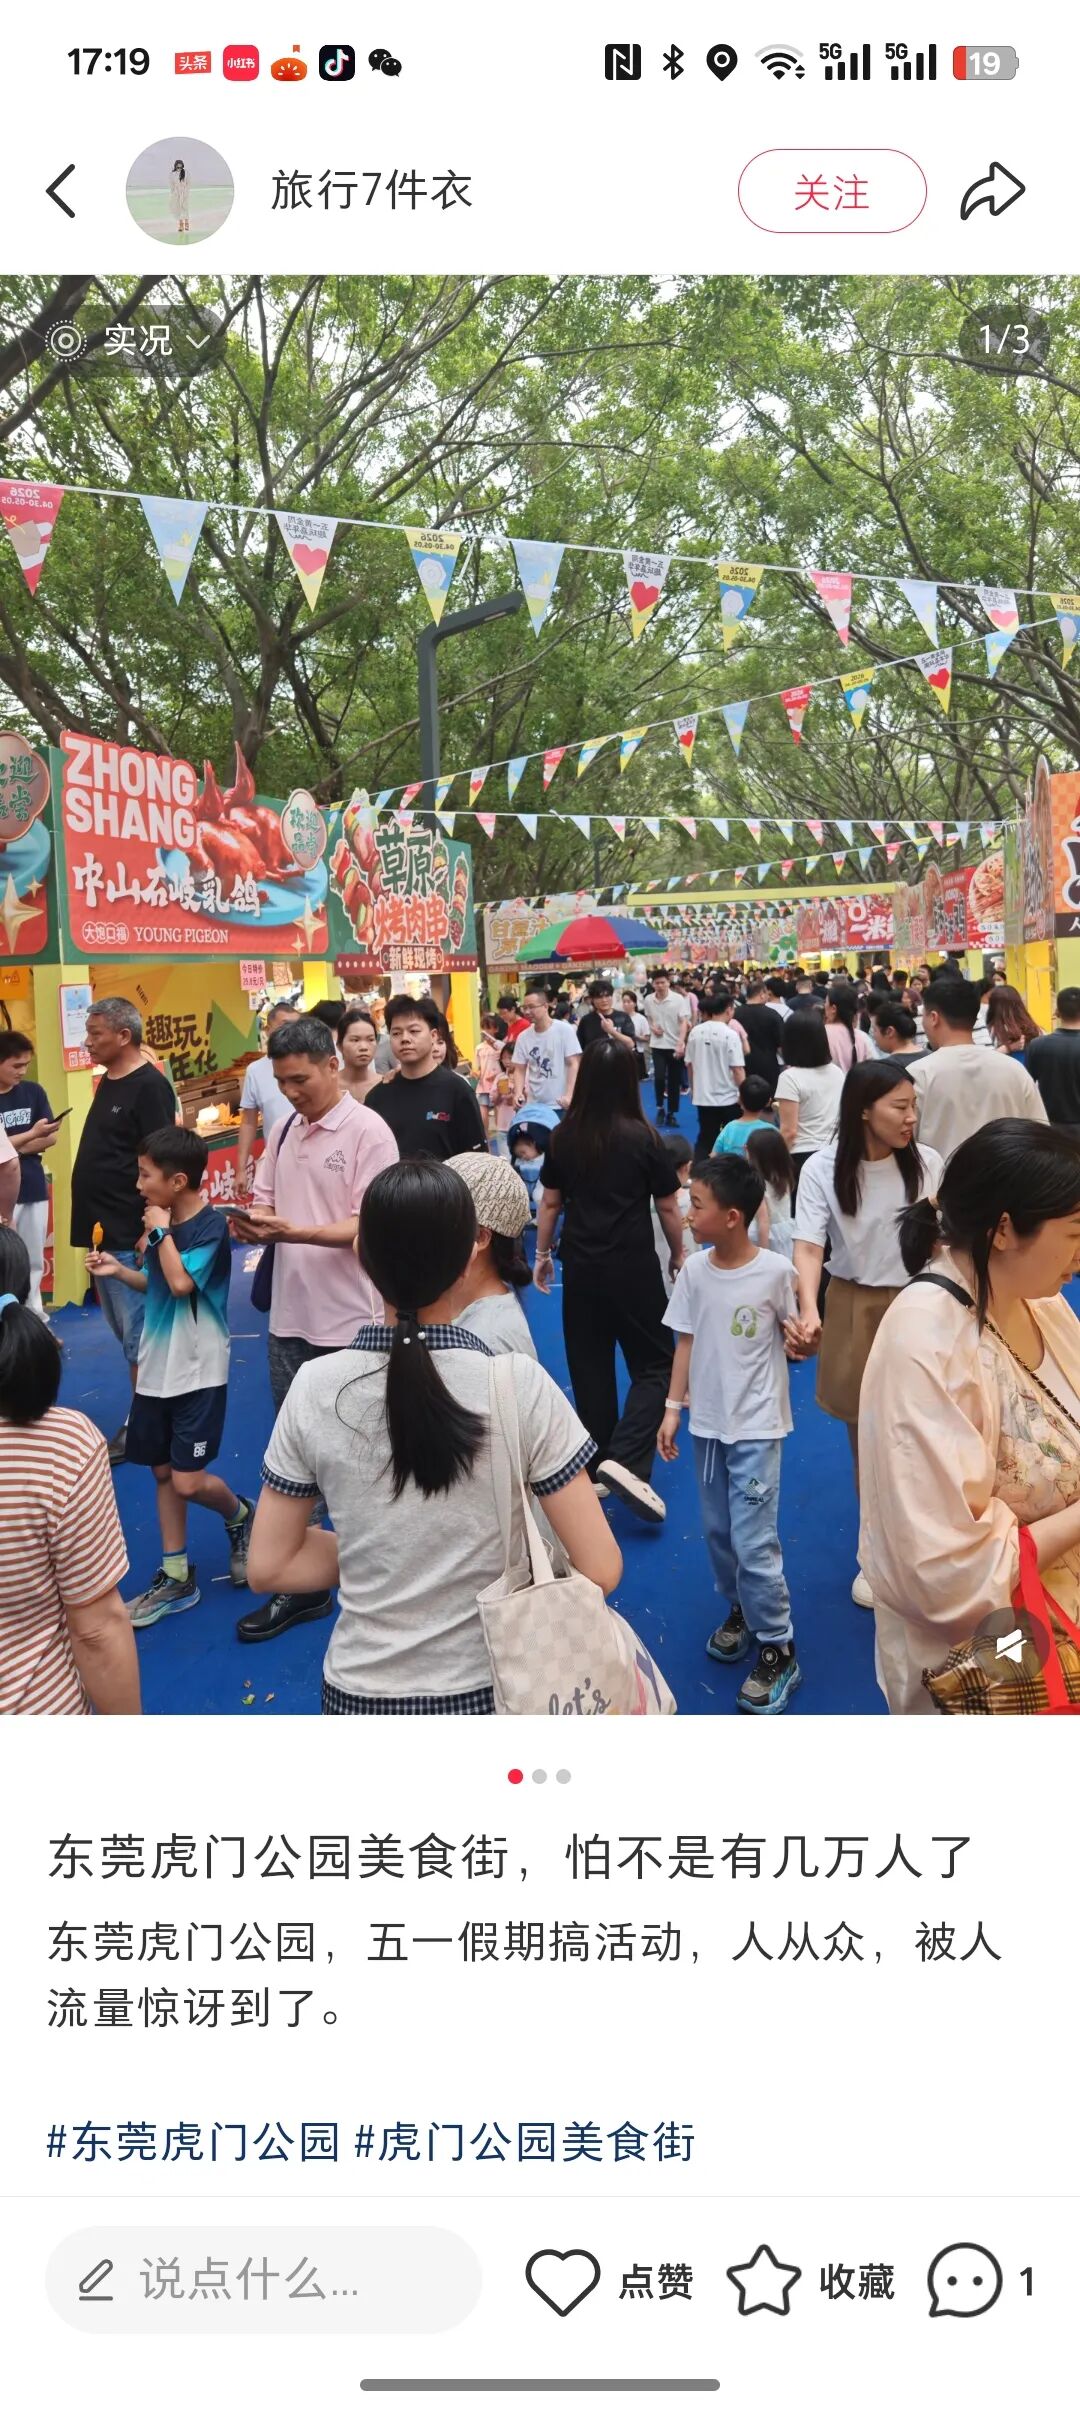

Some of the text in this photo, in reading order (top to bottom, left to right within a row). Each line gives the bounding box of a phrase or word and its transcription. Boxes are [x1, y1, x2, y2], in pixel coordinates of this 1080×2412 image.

[64, 737, 194, 806] ZHONG
[65, 787, 195, 848] SHANG
[289, 807, 320, 833] 欢迎
[72, 852, 260, 917] 中山石岐乳鸽
[375, 824, 435, 897] 草原
[134, 926, 228, 944] YOUNG PIGEON
[374, 895, 448, 952] 烤肉串
[388, 946, 437, 970] 新鲜现烤
[159, 1050, 218, 1081] 年华
